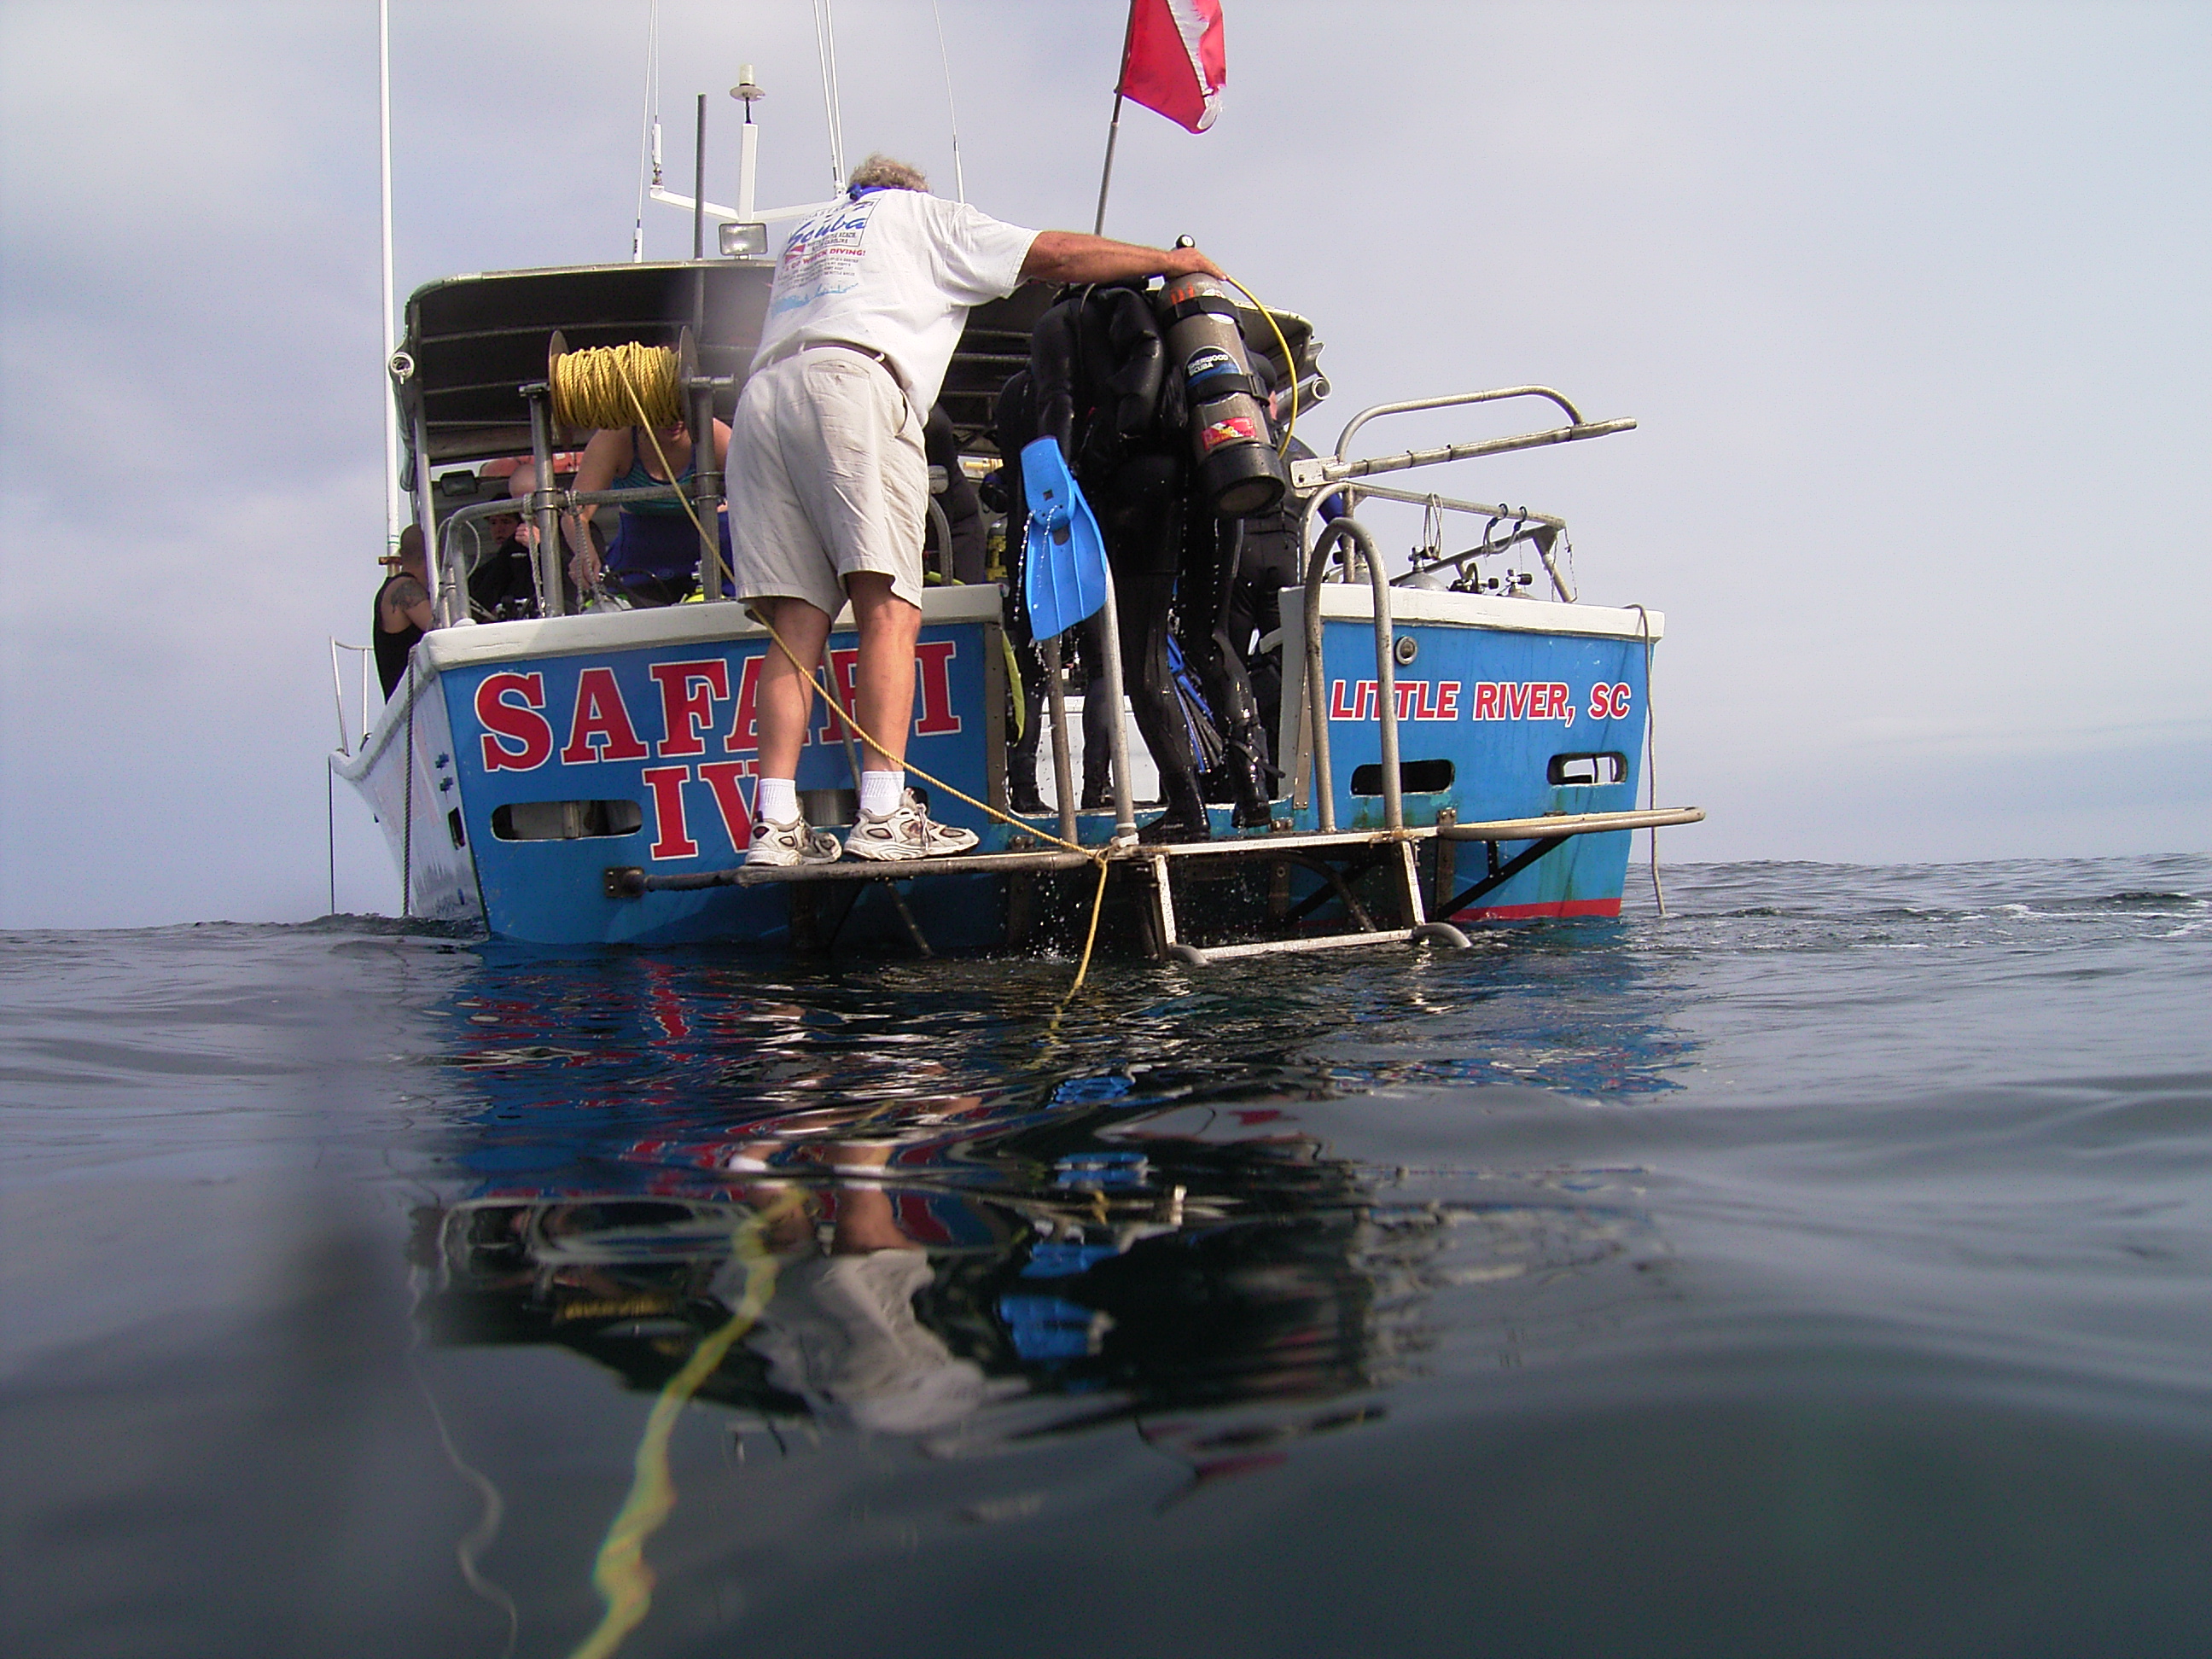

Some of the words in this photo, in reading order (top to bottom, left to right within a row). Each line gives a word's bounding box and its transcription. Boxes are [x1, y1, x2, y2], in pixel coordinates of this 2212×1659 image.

[783, 213, 867, 258] Scuba
[830, 247, 866, 257] DIVING!
[1188, 354, 1229, 370] SHERWOOD
[1189, 362, 1214, 376] SCUBA
[1329, 679, 1461, 722] LITTLE
[1472, 680, 1576, 728] RIVER,
[1587, 681, 1632, 721] SC
[642, 759, 761, 861] IV
